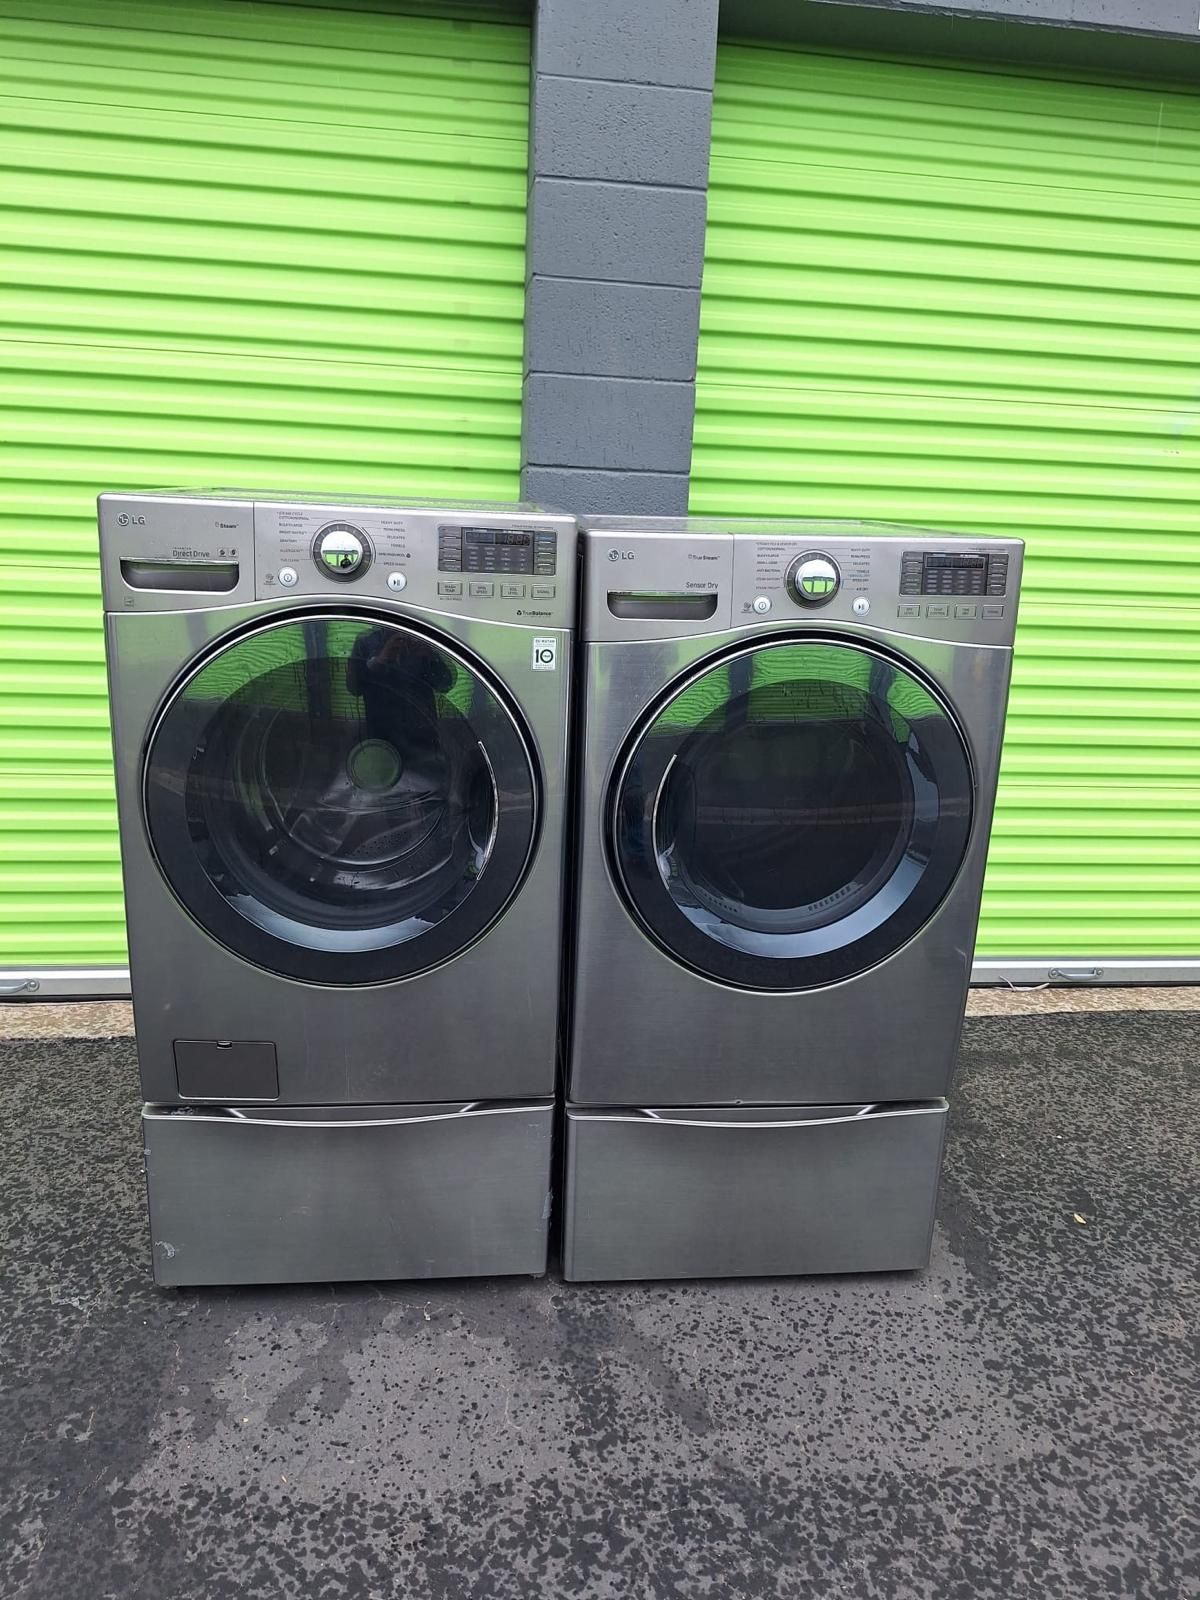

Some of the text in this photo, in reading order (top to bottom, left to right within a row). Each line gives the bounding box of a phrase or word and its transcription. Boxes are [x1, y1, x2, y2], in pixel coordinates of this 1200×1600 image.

[131, 516, 145, 525] LG
[172, 550, 210, 558] Direct Drive
[621, 551, 635, 560] LG
